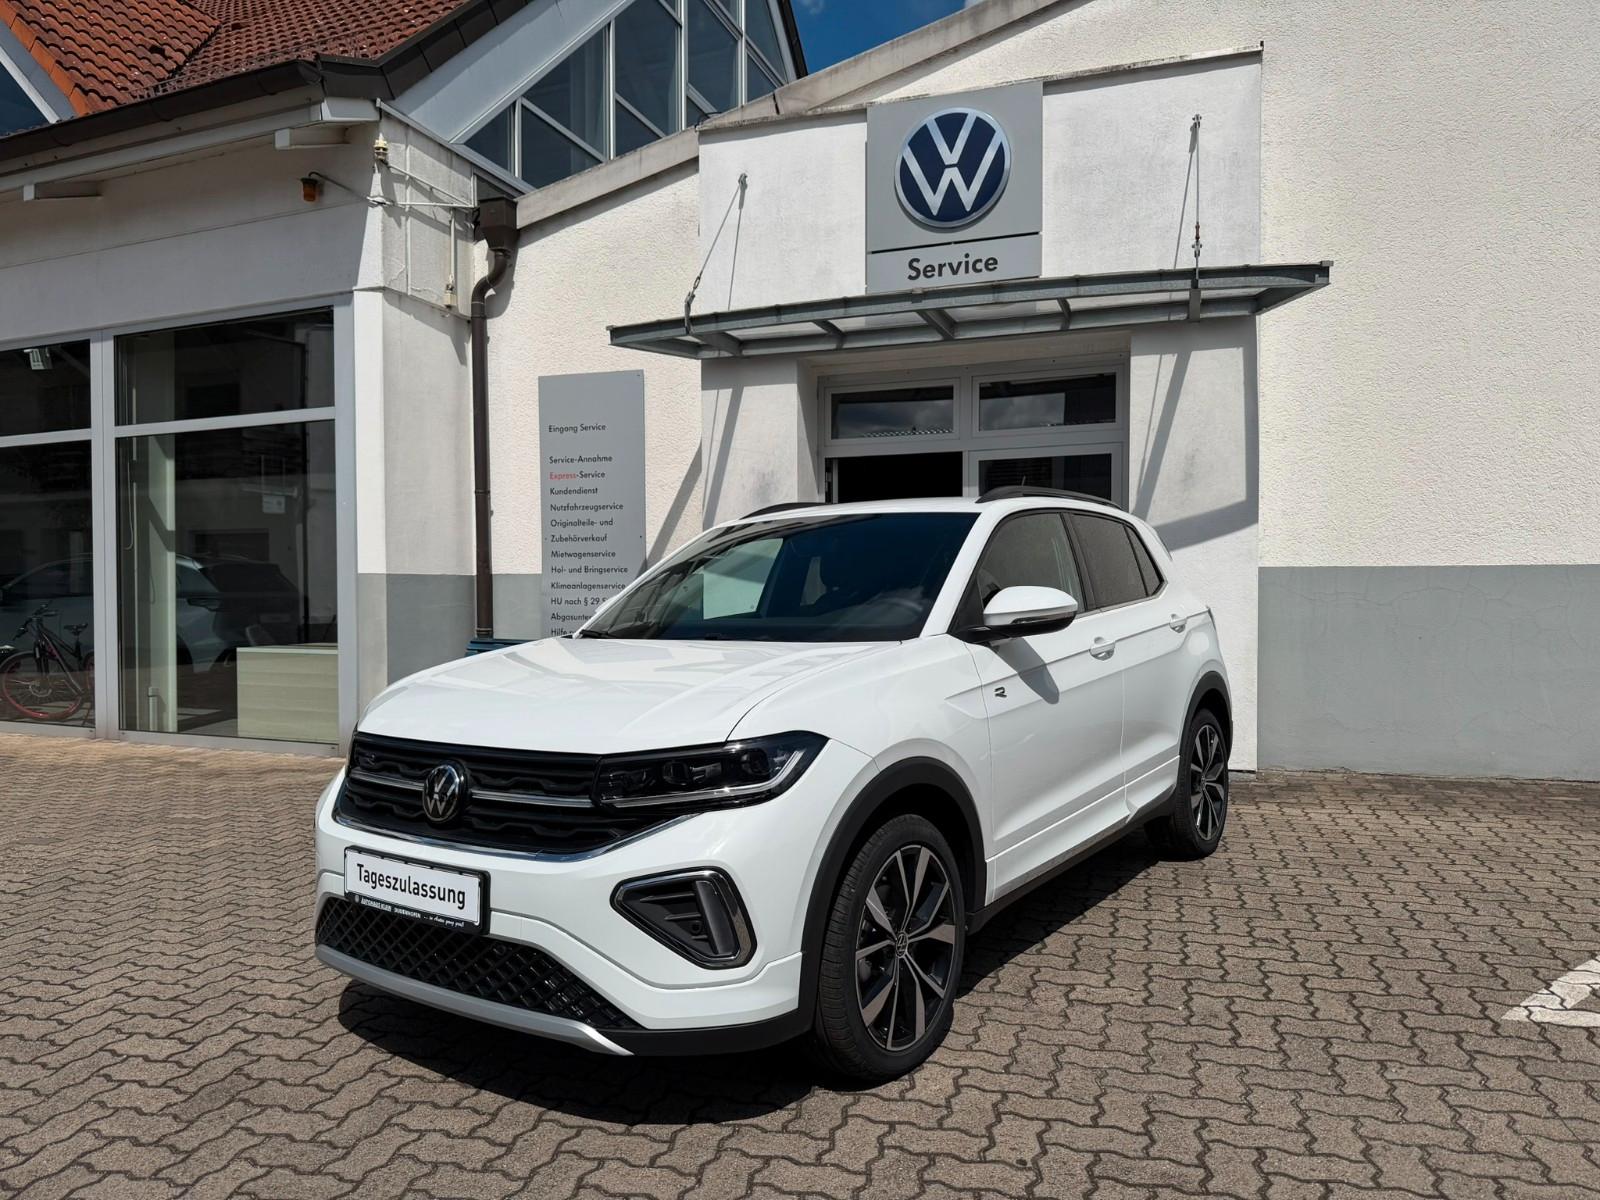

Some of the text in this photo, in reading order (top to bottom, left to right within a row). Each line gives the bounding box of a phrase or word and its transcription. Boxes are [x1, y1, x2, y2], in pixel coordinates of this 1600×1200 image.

[896, 108, 1009, 227] VW
[907, 253, 998, 281] Service
[548, 423, 606, 434] Eingang Service
[548, 454, 613, 464] Service-Annahme
[549, 470, 606, 480] Express-Service
[549, 487, 598, 496] Kundendienst
[550, 502, 624, 512] Nutzfahrzeugservice
[550, 517, 614, 528] Originalteile- und
[550, 533, 608, 543] Zubehörverkauf
[550, 550, 616, 559] Mietwagenservice
[551, 565, 628, 575] Hol- und Bringservice
[550, 582, 626, 591] Klimaanlagenservice
[550, 597, 563, 605] HU
[564, 597, 582, 605] nach
[583, 597, 589, 606] §
[590, 597, 600, 605] 29
[551, 627, 567, 636] Hilfe
[357, 863, 466, 910] Tageszulassung
